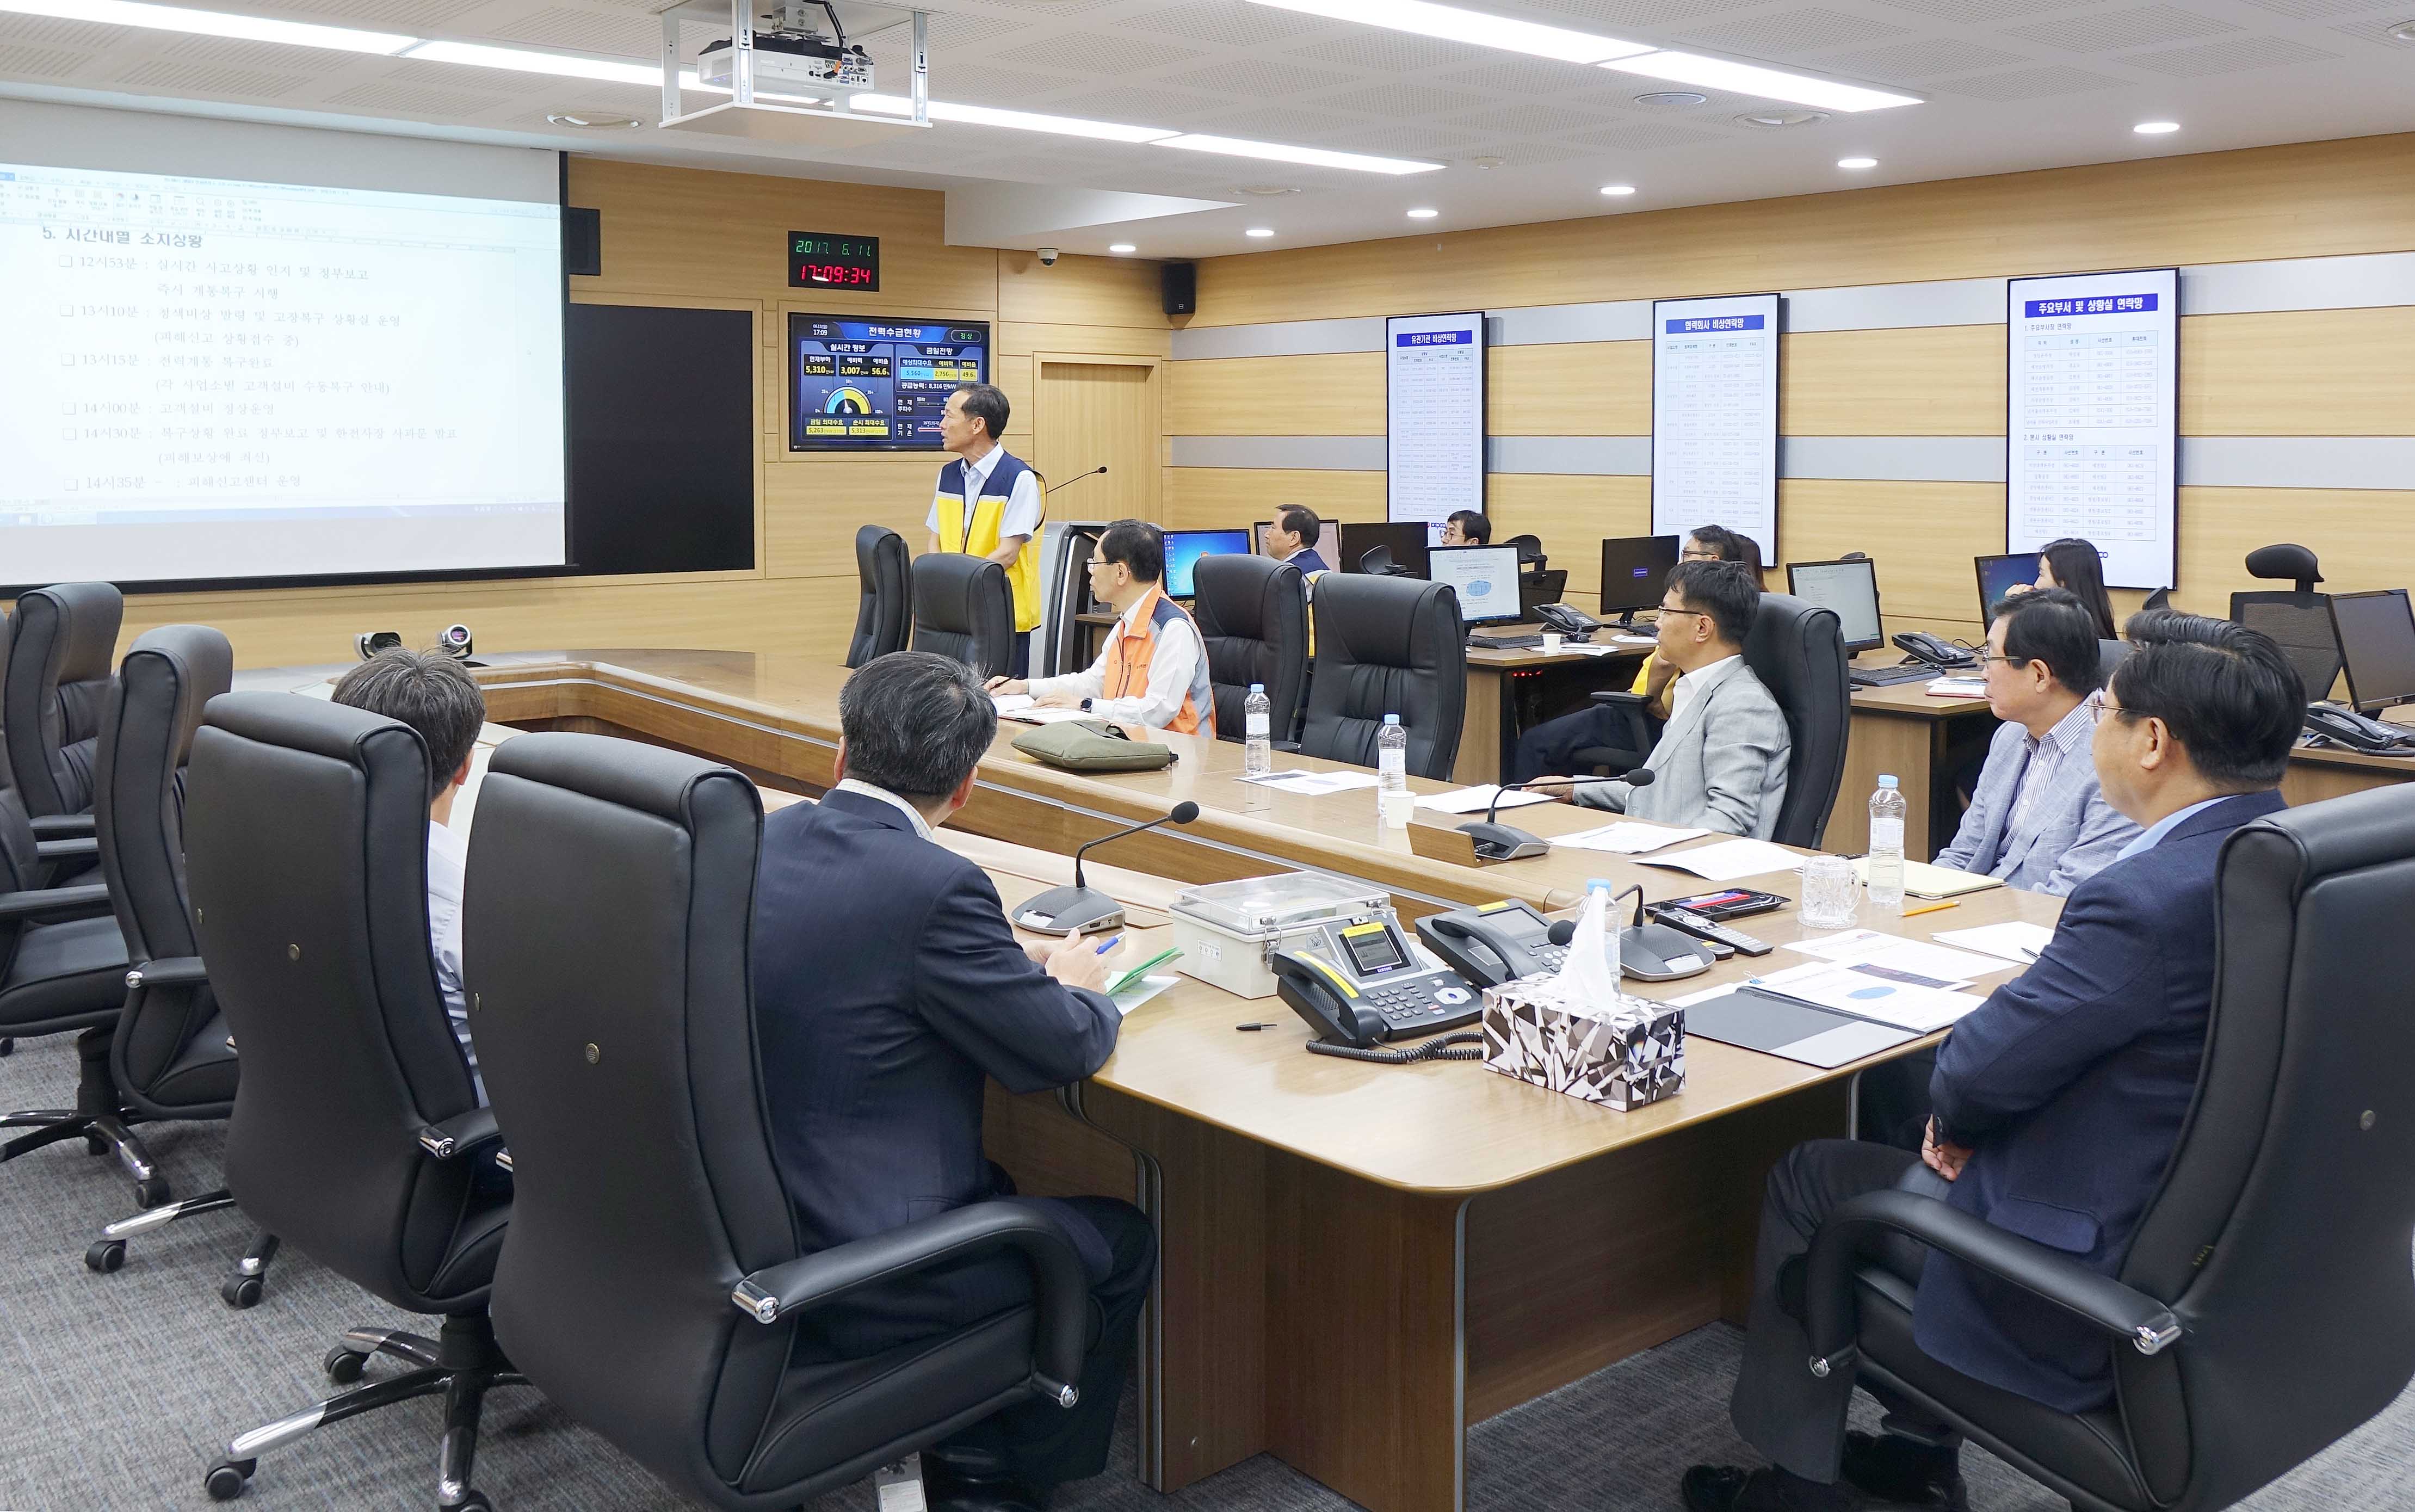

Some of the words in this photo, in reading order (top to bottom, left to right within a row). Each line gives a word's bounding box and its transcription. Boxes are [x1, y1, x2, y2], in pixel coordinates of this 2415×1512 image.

[2039, 301, 2072, 314] 주요부서
[2075, 301, 2084, 312] 및
[2087, 298, 2114, 312] 상황실
[2117, 297, 2144, 310] 연락망
[1685, 319, 1710, 331] 협력회사
[1713, 317, 1744, 330] 비상연락망
[868, 326, 921, 338] 전력수급현황
[1411, 335, 1431, 344] 유관기관
[1432, 333, 1457, 343] 비상연락망
[830, 343, 851, 352] 실시간
[852, 344, 866, 353] 정보
[926, 347, 953, 356] 금일전망
